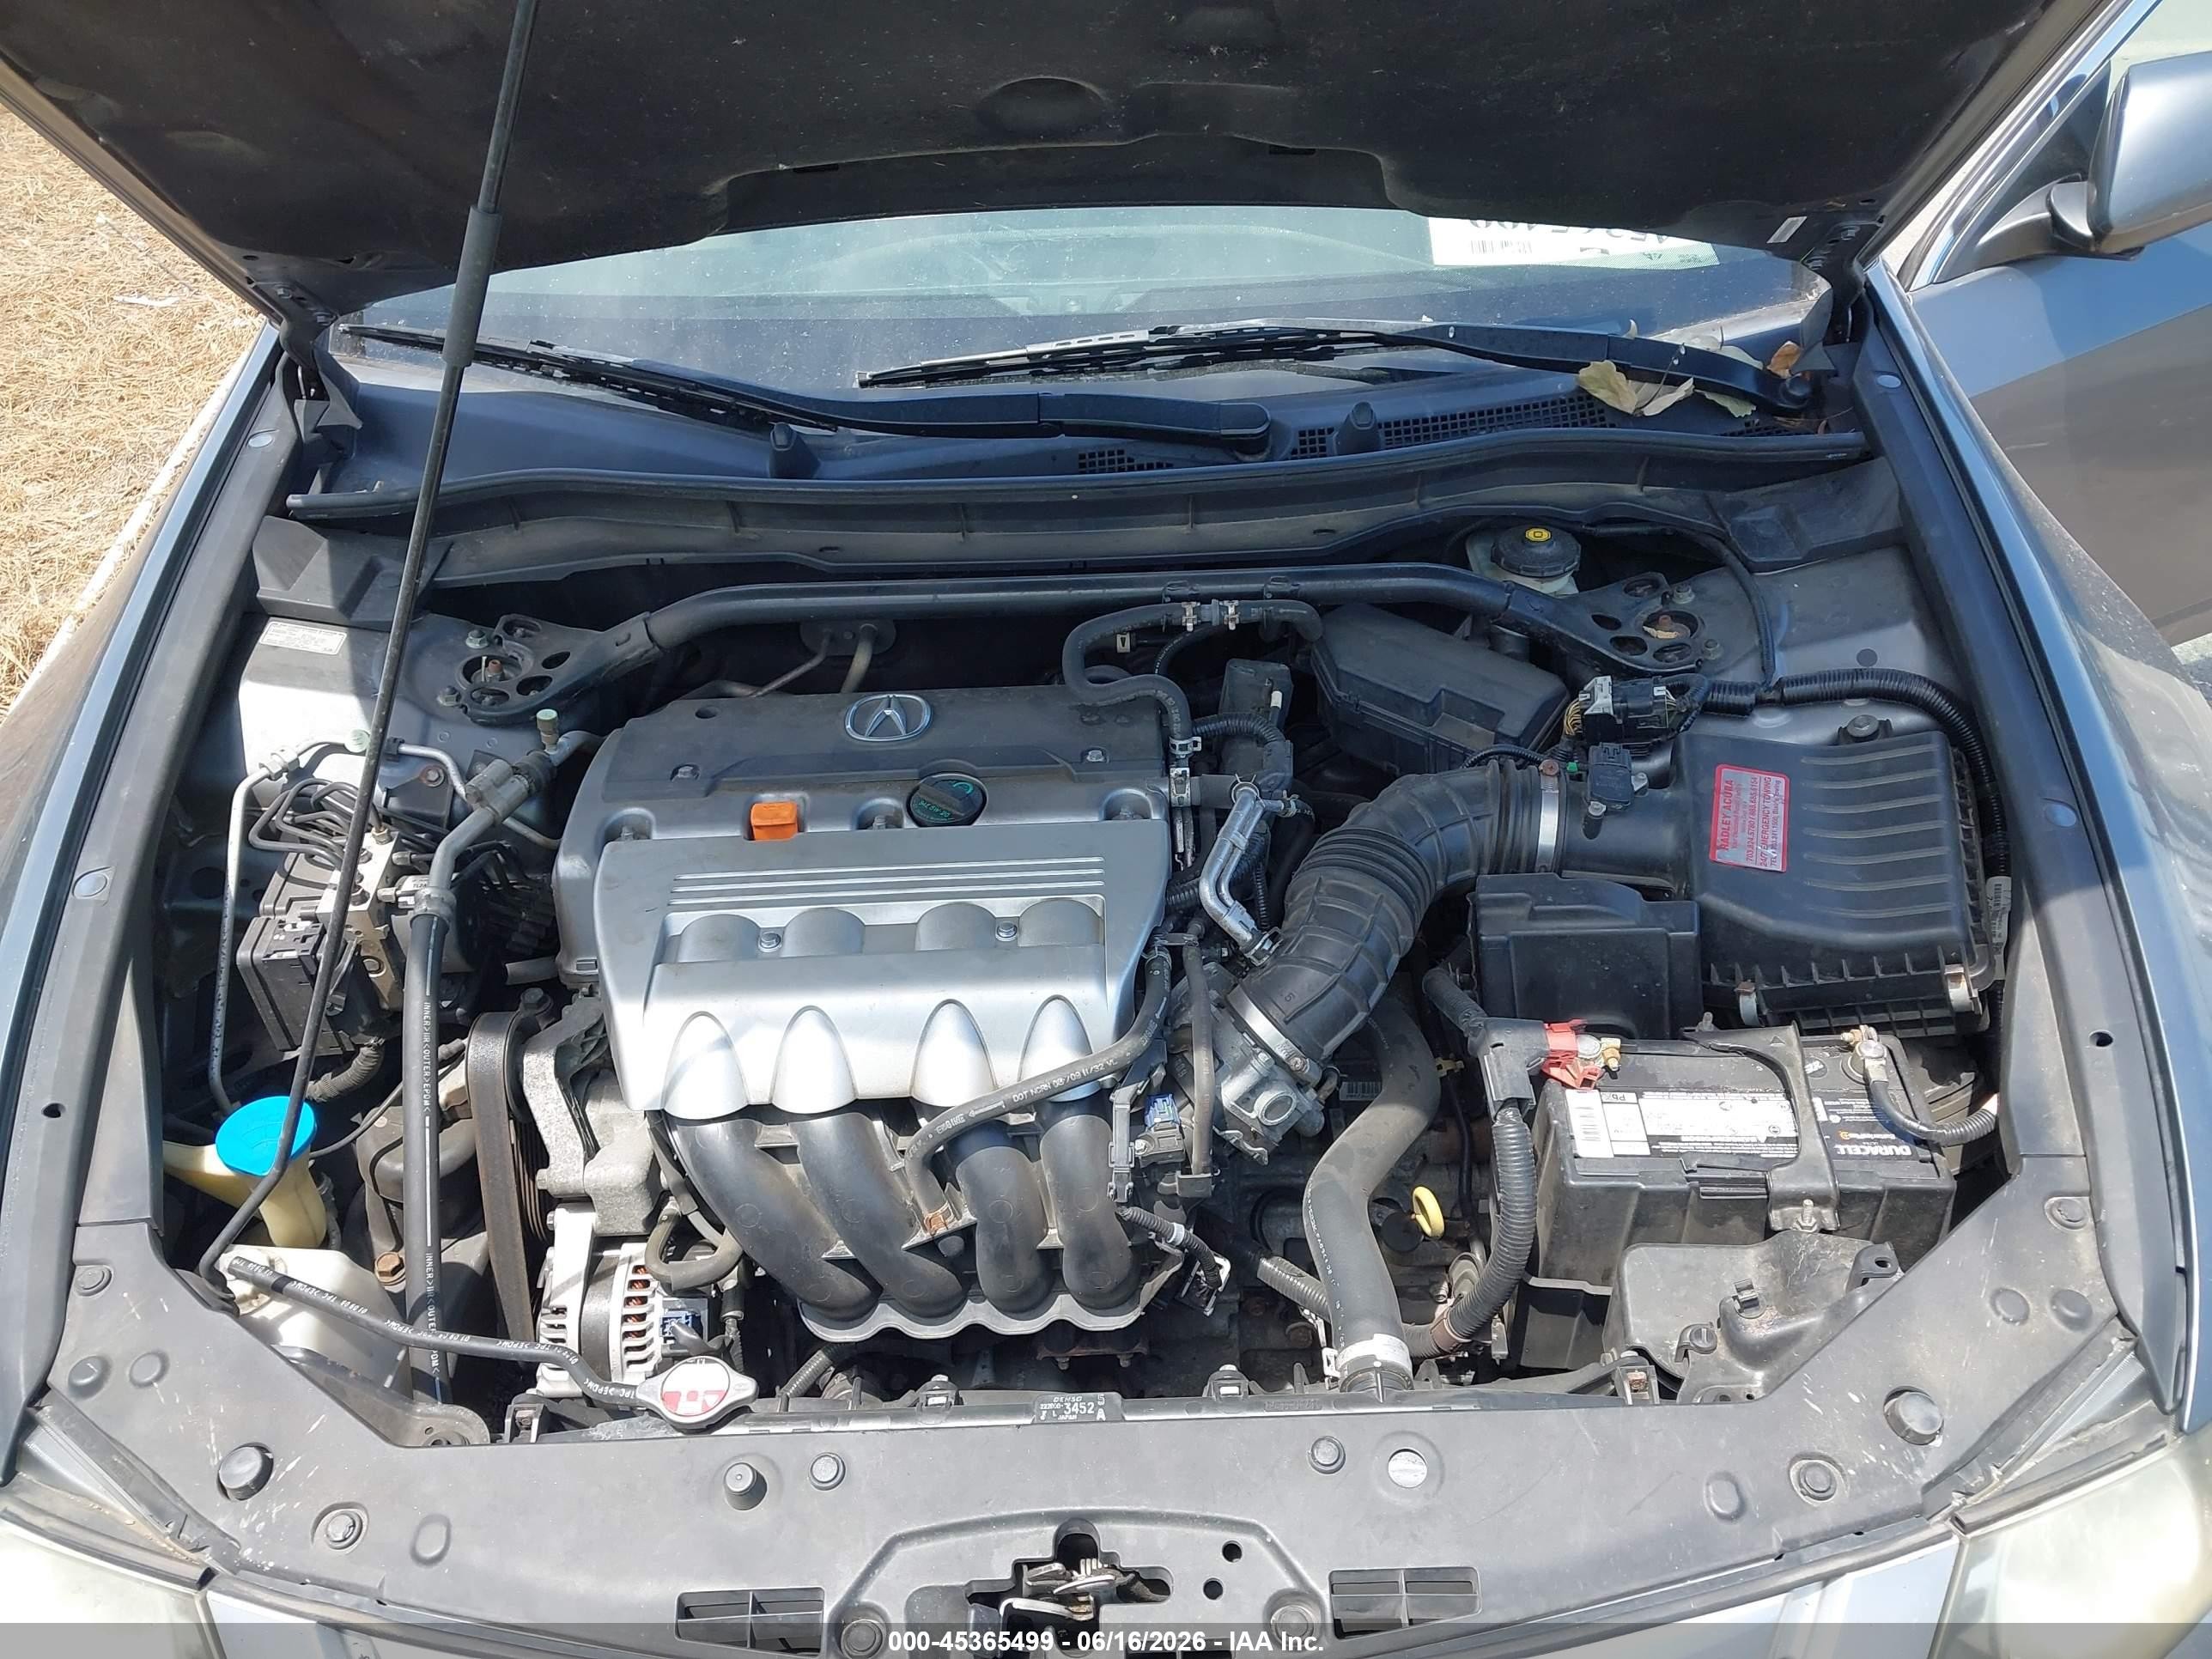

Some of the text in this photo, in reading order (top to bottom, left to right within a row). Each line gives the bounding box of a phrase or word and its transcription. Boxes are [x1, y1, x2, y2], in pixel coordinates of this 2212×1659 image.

[1763, 776, 1771, 804] TOWING
[1720, 779, 1733, 851] RADLEY ACURA
[1760, 802, 1770, 850] EMERGENCY
[1012, 1090, 1028, 1103] DOT
[1836, 1144, 1911, 1156] DURACELL
